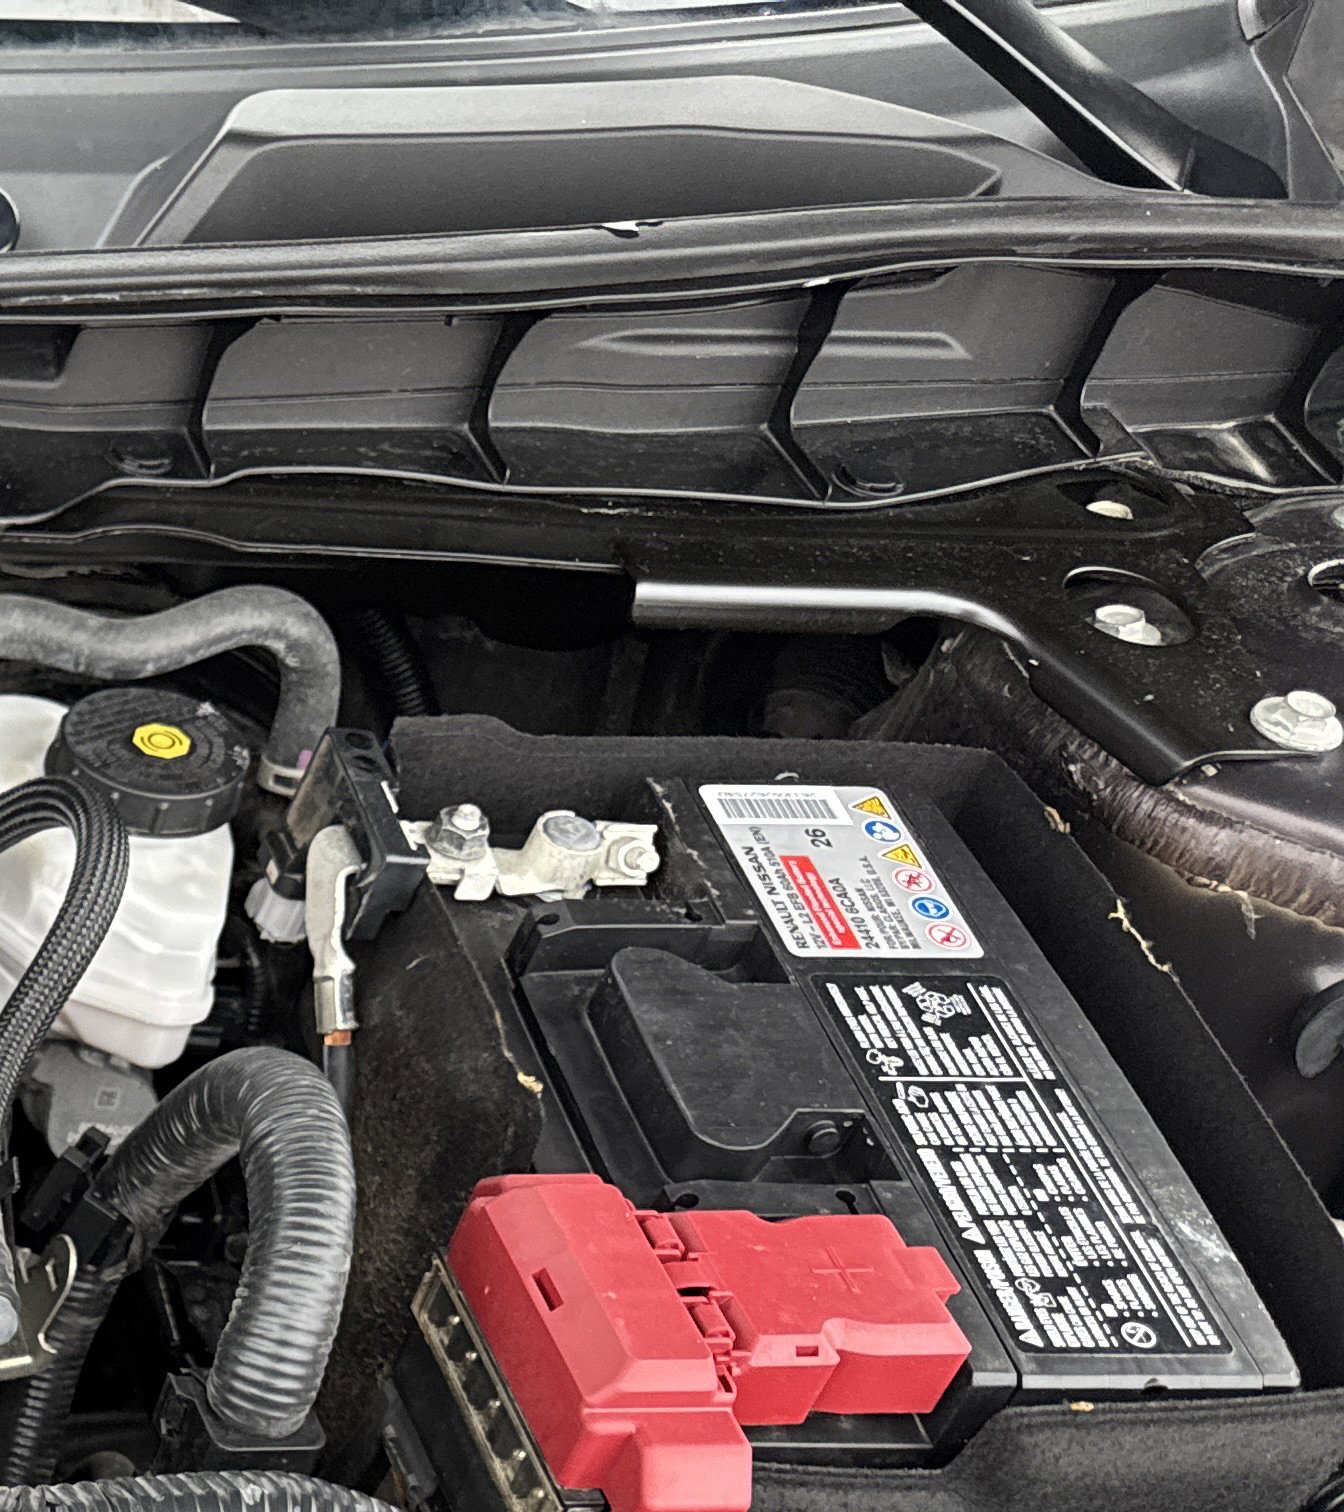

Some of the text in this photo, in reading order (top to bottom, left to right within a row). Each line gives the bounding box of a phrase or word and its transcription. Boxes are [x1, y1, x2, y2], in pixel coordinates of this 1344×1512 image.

[802, 828, 834, 848] 26
[740, 846, 780, 895] NISSAN
[770, 899, 811, 949] RENAULT
[848, 915, 881, 949] 24410
